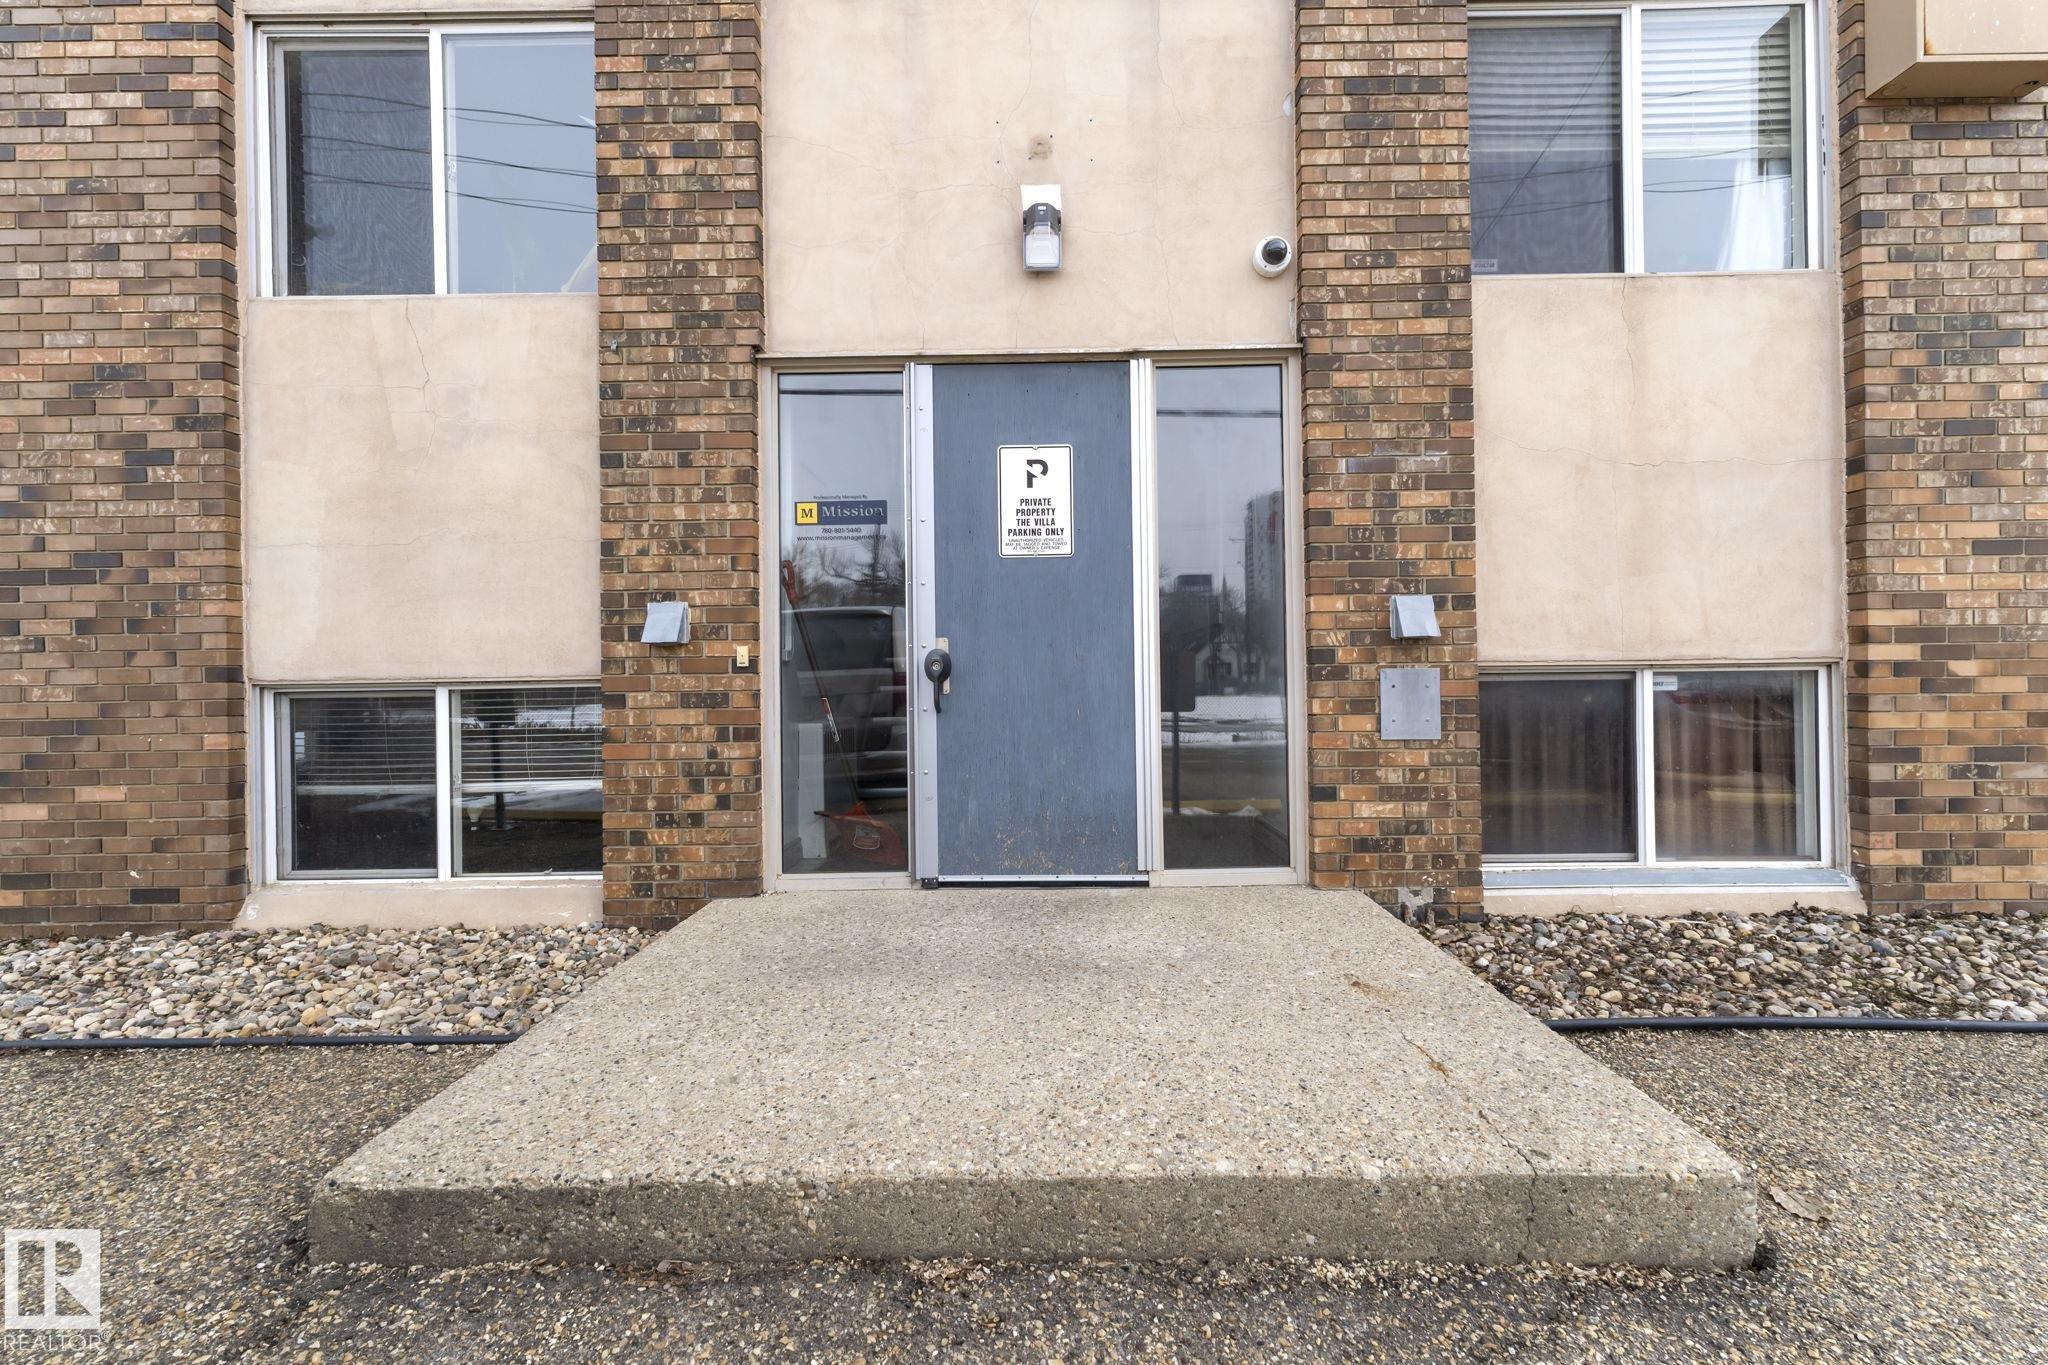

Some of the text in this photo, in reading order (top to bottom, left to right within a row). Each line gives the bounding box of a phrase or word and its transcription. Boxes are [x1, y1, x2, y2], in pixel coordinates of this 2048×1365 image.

[1026, 459, 1049, 488] P
[1020, 498, 1052, 506] PRIVATE
[801, 504, 884, 518] M Mission
[1016, 508, 1056, 517] PROPERTY
[1016, 518, 1056, 526] THE VILLA
[1007, 527, 1065, 537] PARKING ONLY
